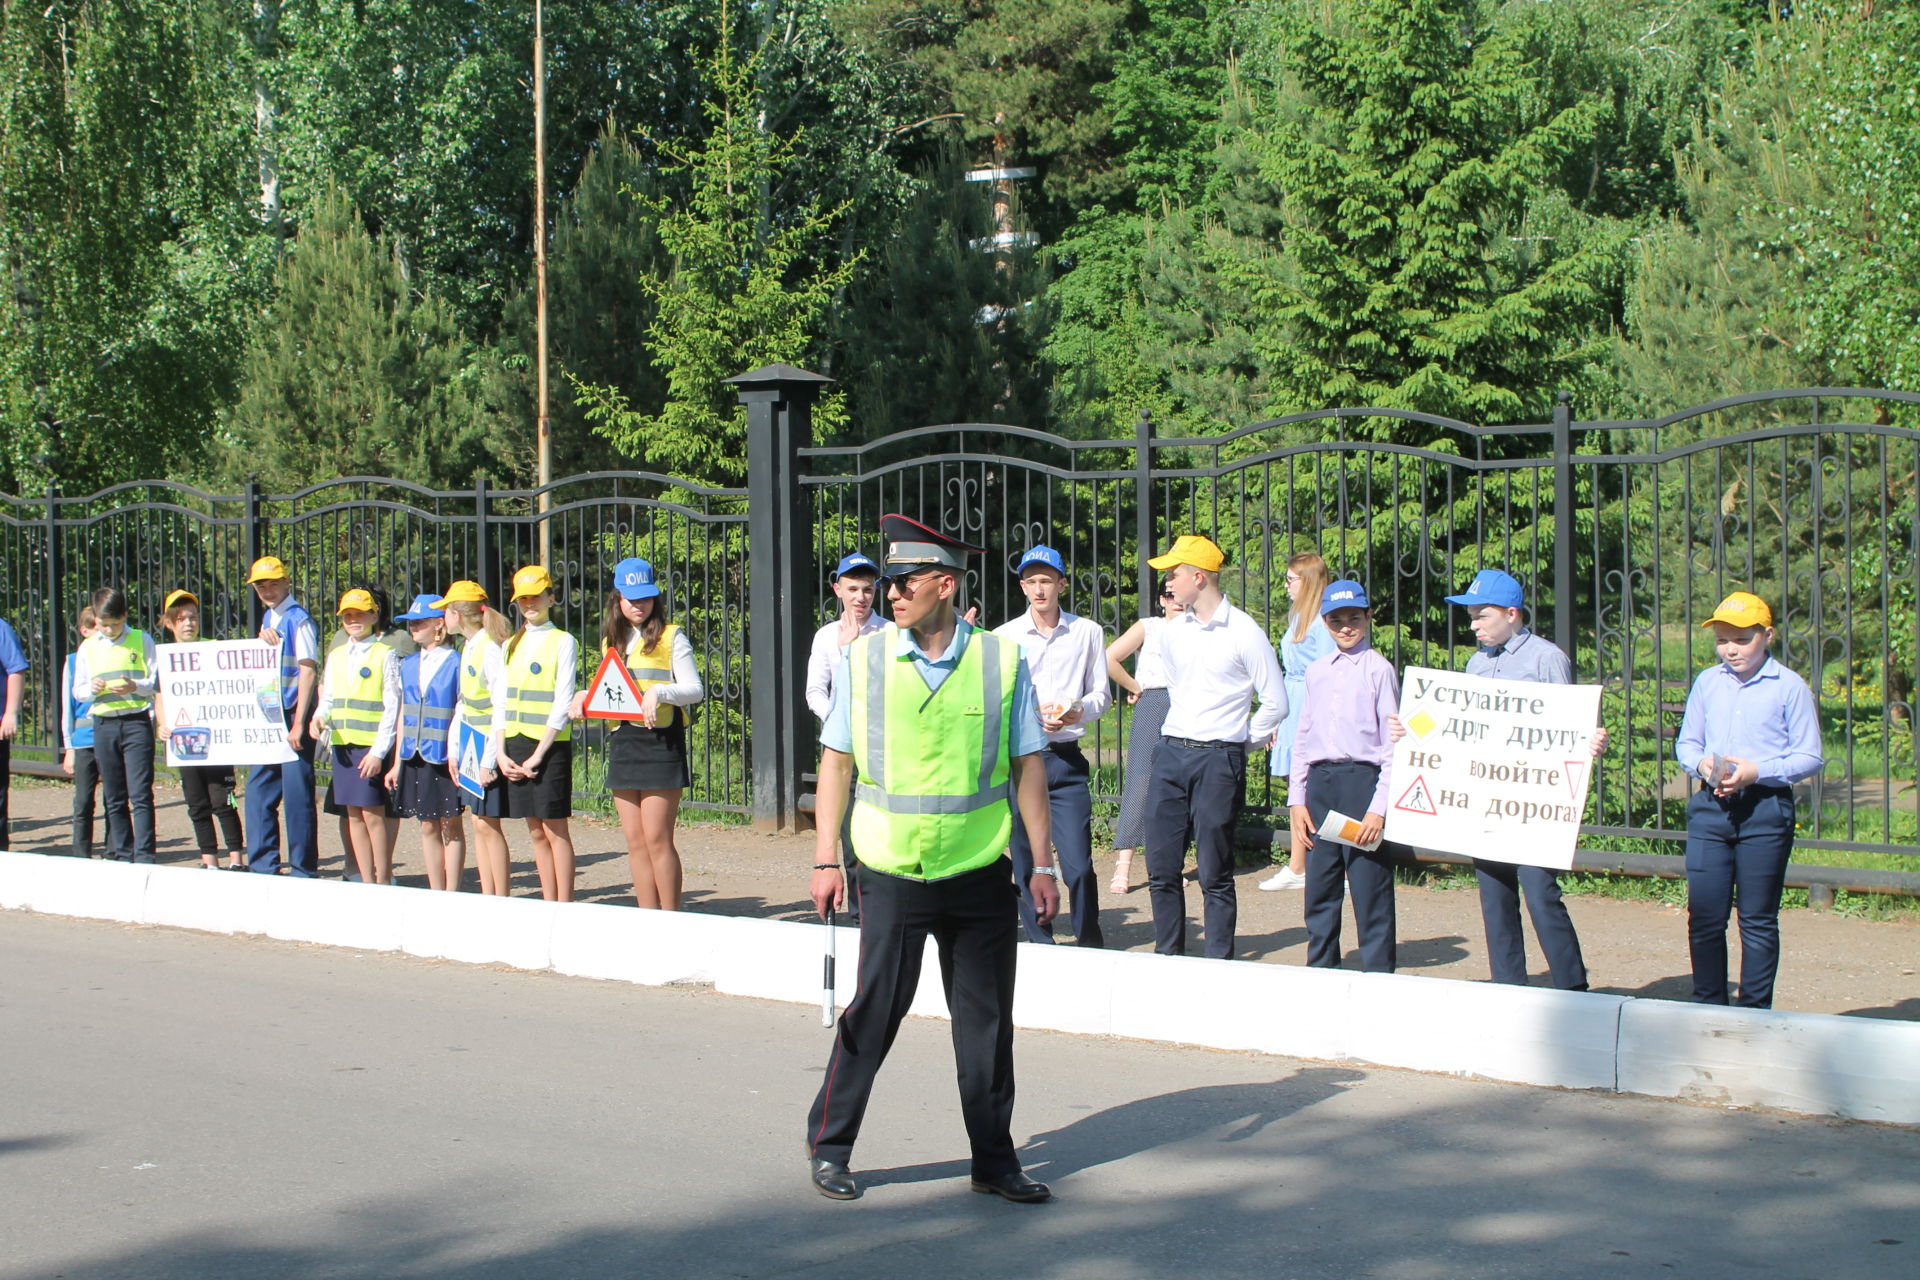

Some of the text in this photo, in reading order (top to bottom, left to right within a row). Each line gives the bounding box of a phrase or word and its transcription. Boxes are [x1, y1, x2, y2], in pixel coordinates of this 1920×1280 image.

[625, 571, 649, 586] ЮИД
[1330, 590, 1354, 601] ЮИД
[168, 648, 278, 673] НЕ СПЕШИ
[171, 674, 255, 697] ОБРАТНОЙ
[196, 703, 256, 723] ДОРОГИ
[213, 727, 284, 745] НЕ БУДЕТ
[1442, 716, 1490, 744] друг
[1408, 750, 1560, 786] не воюйте
[1439, 788, 1579, 825] на дорогах
